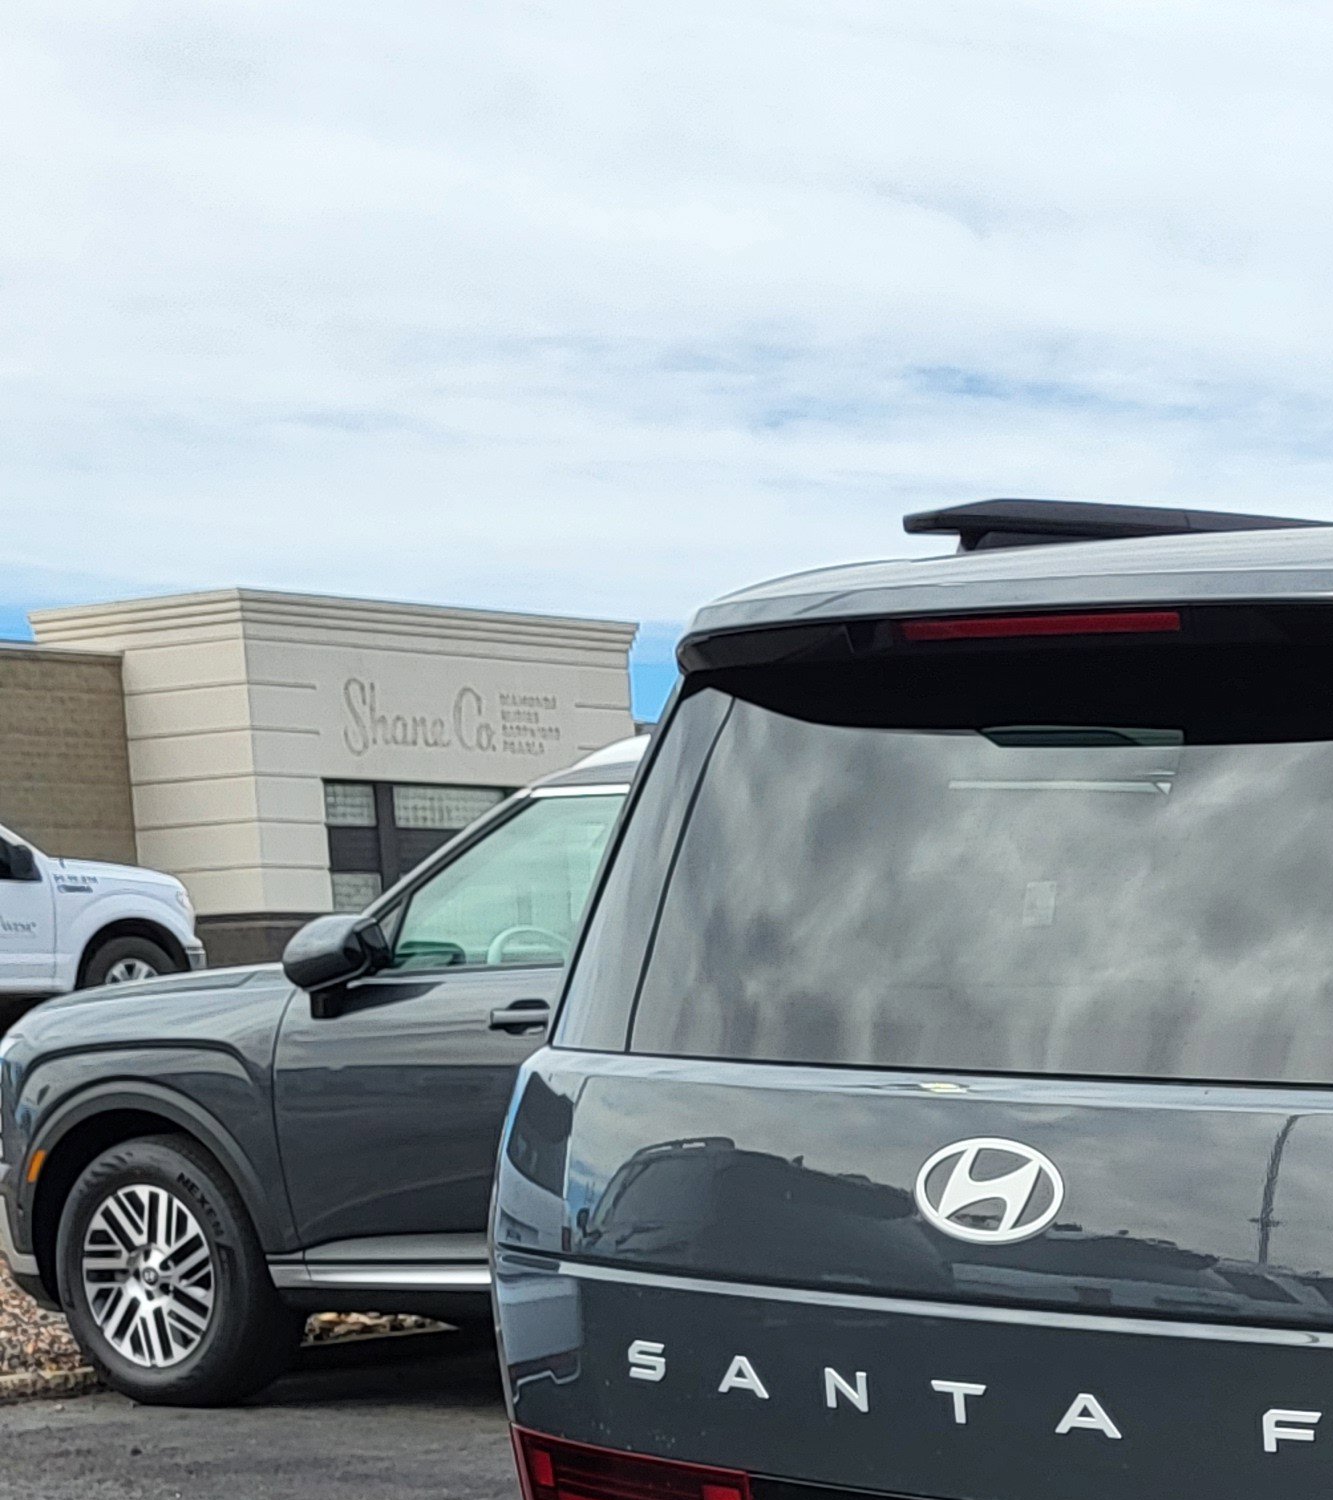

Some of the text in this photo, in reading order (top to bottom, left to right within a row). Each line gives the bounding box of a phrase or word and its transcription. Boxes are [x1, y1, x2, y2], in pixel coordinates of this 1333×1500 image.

[344, 678, 496, 757] Shane Co.
[627, 1339, 1122, 1440] SANTA
